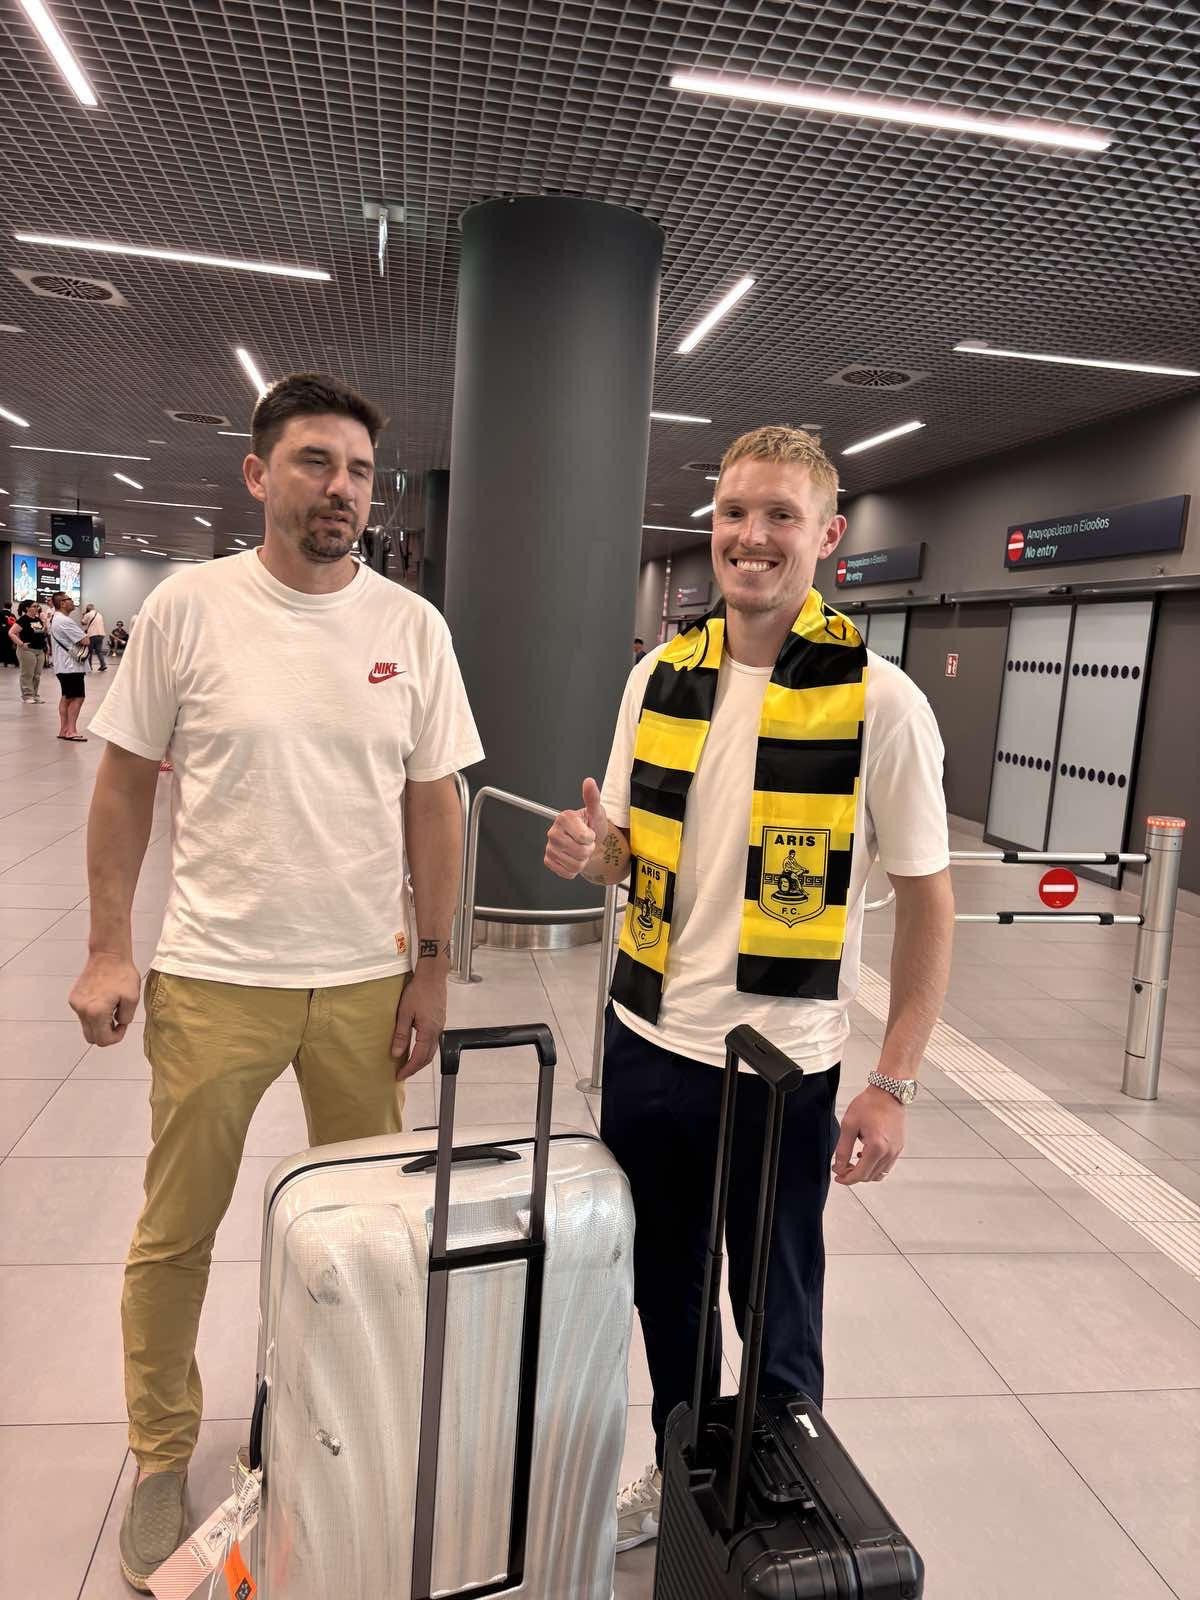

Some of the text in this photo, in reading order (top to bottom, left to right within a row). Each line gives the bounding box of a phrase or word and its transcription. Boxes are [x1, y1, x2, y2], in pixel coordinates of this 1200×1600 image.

[1025, 544, 1058, 560] No entry
[373, 662, 398, 674] NIKE
[774, 834, 816, 847] ARIS
[641, 864, 661, 881] ARIS
